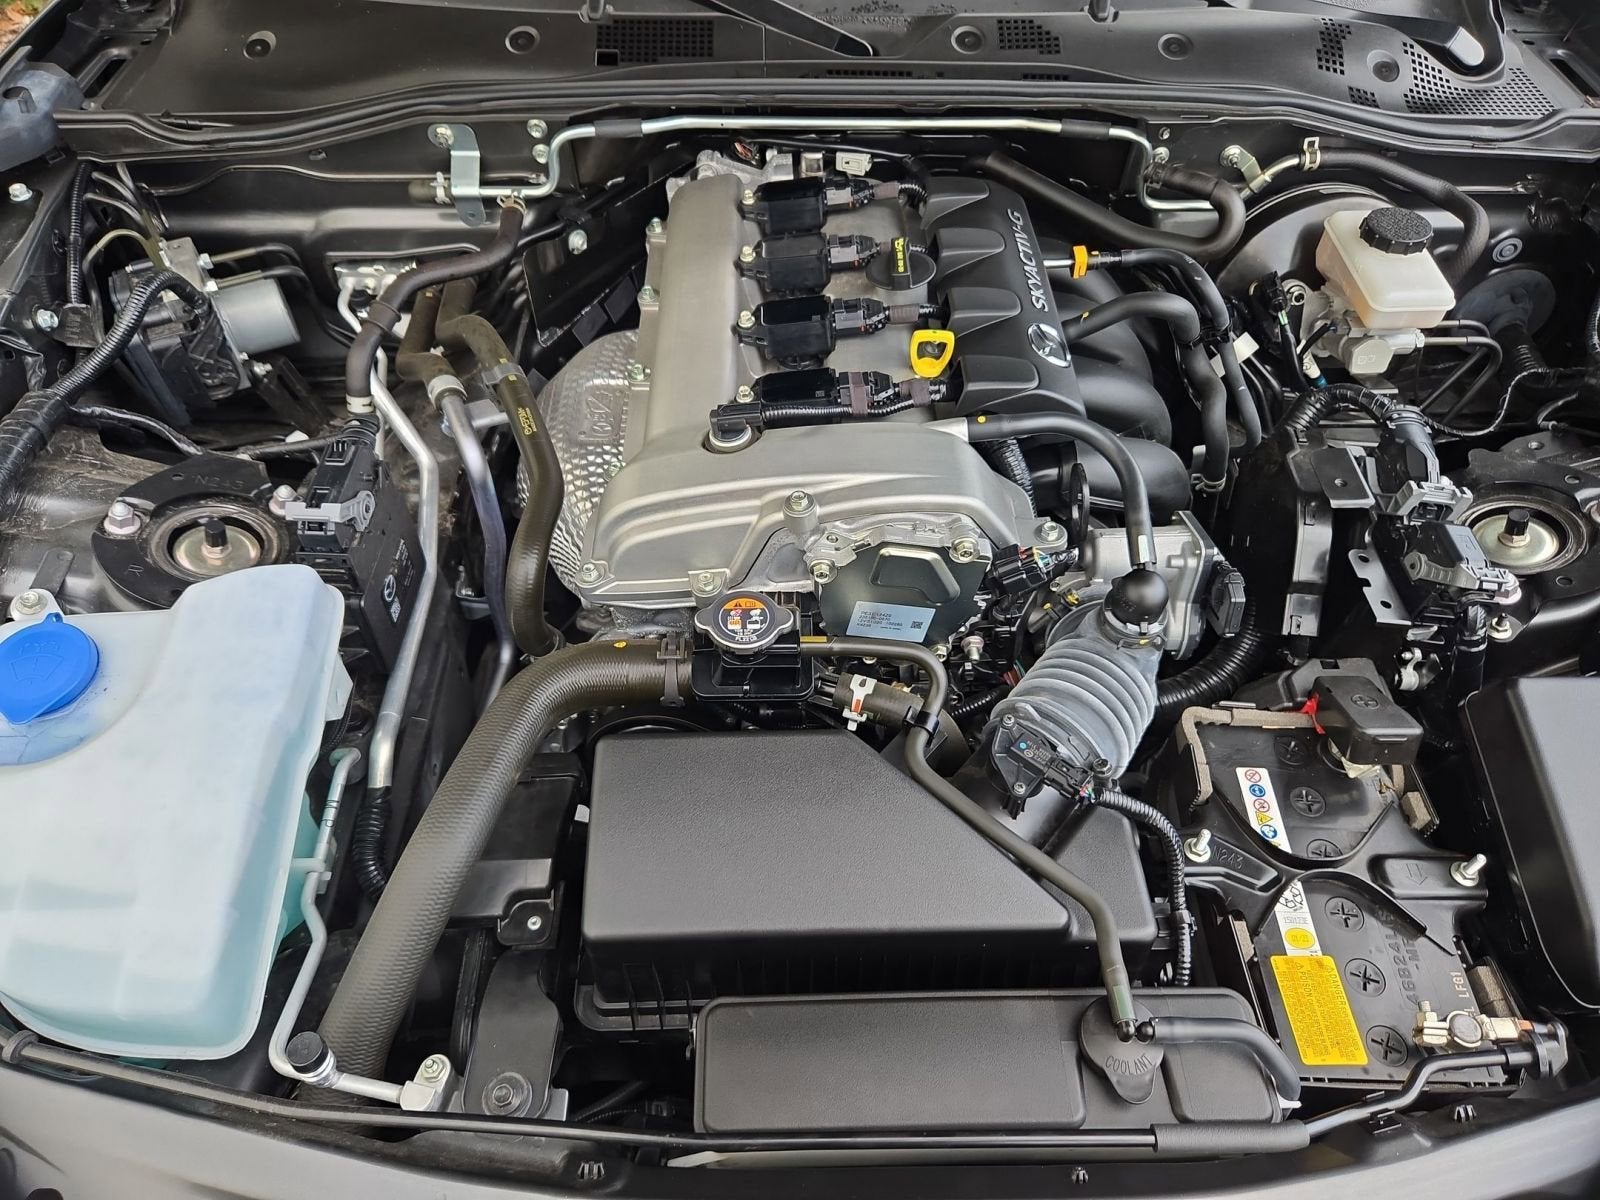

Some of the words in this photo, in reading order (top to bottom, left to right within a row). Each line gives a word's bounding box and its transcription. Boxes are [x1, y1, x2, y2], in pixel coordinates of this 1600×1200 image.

[1007, 208, 1049, 312] SKYACTIV-G
[1297, 971, 1314, 997] POISON
[1328, 973, 1346, 1005] DANGER
[1105, 1053, 1153, 1075] COOLANT
